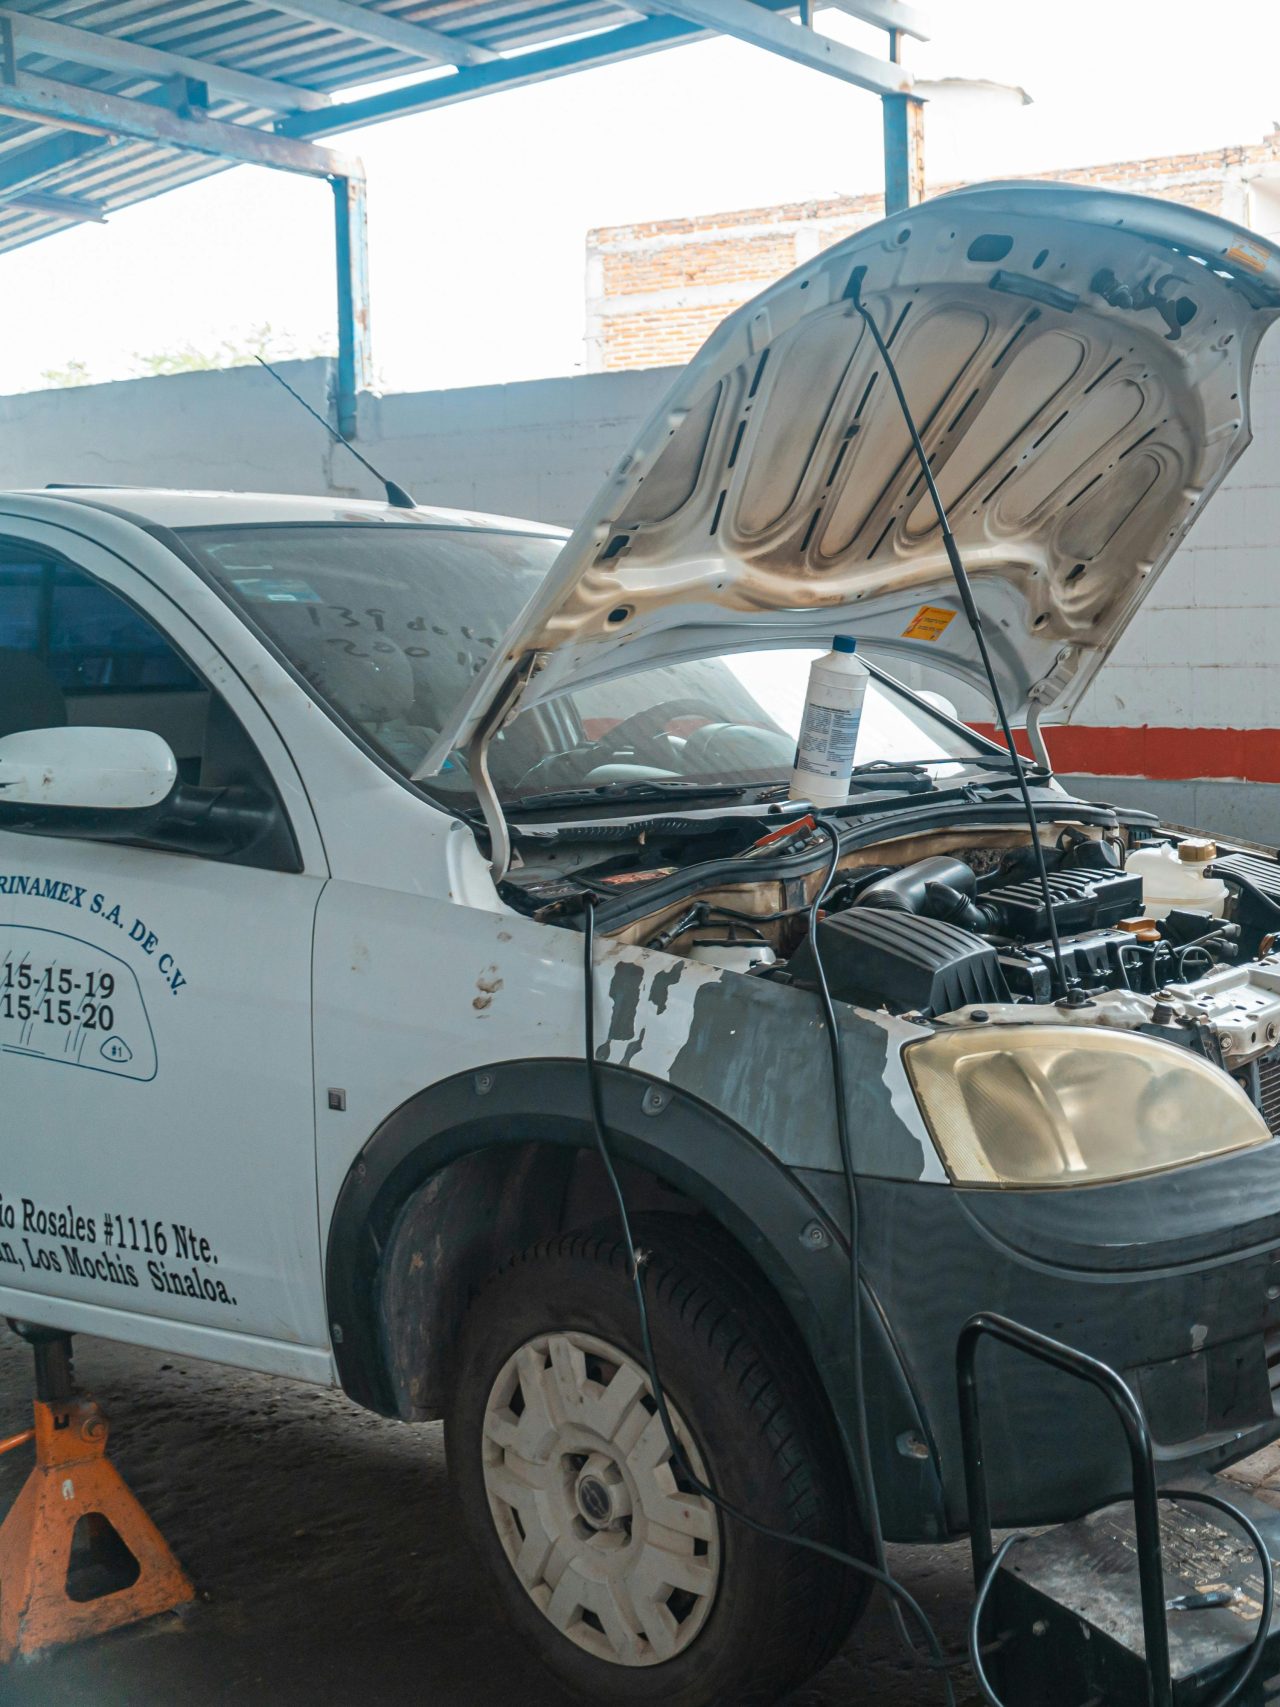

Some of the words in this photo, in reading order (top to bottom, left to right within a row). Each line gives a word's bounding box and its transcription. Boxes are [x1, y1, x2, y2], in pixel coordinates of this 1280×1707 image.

[89, 893, 125, 929] S.A.
[128, 918, 160, 955] DE
[157, 953, 188, 996] C.V.
[2, 993, 115, 1032] 15-15-20
[3, 962, 116, 1000] 15-15-19
[21, 1198, 97, 1244] Rosales
[103, 1213, 168, 1256] #1116
[171, 1223, 219, 1265] Nte.
[22, 1238, 63, 1274] Los
[61, 1245, 140, 1288] Mochis
[147, 1260, 238, 1306] Sinaloa.
